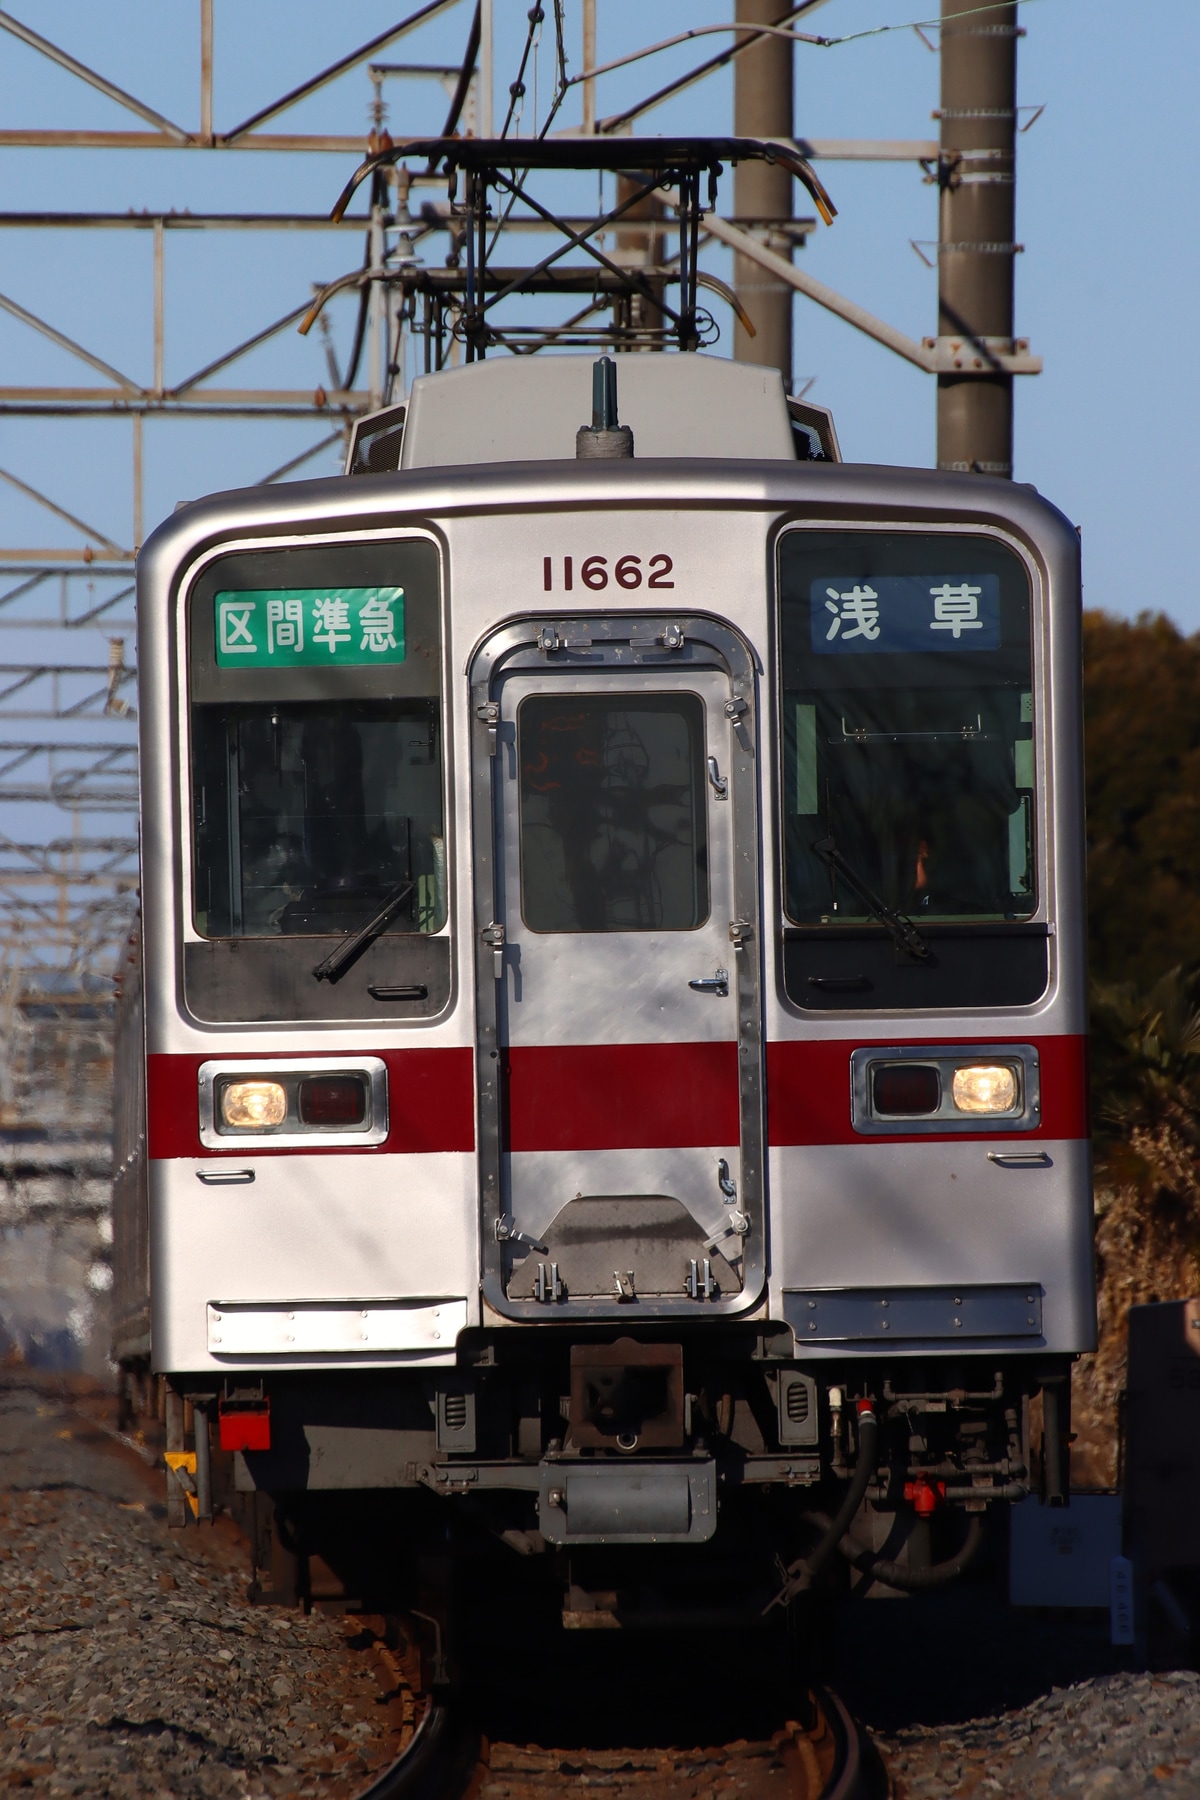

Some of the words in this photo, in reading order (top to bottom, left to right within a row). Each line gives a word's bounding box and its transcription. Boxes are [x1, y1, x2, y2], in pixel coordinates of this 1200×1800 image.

[543, 554, 675, 592] 11662
[219, 597, 398, 654] 区間準急
[825, 584, 983, 640] 浅草
